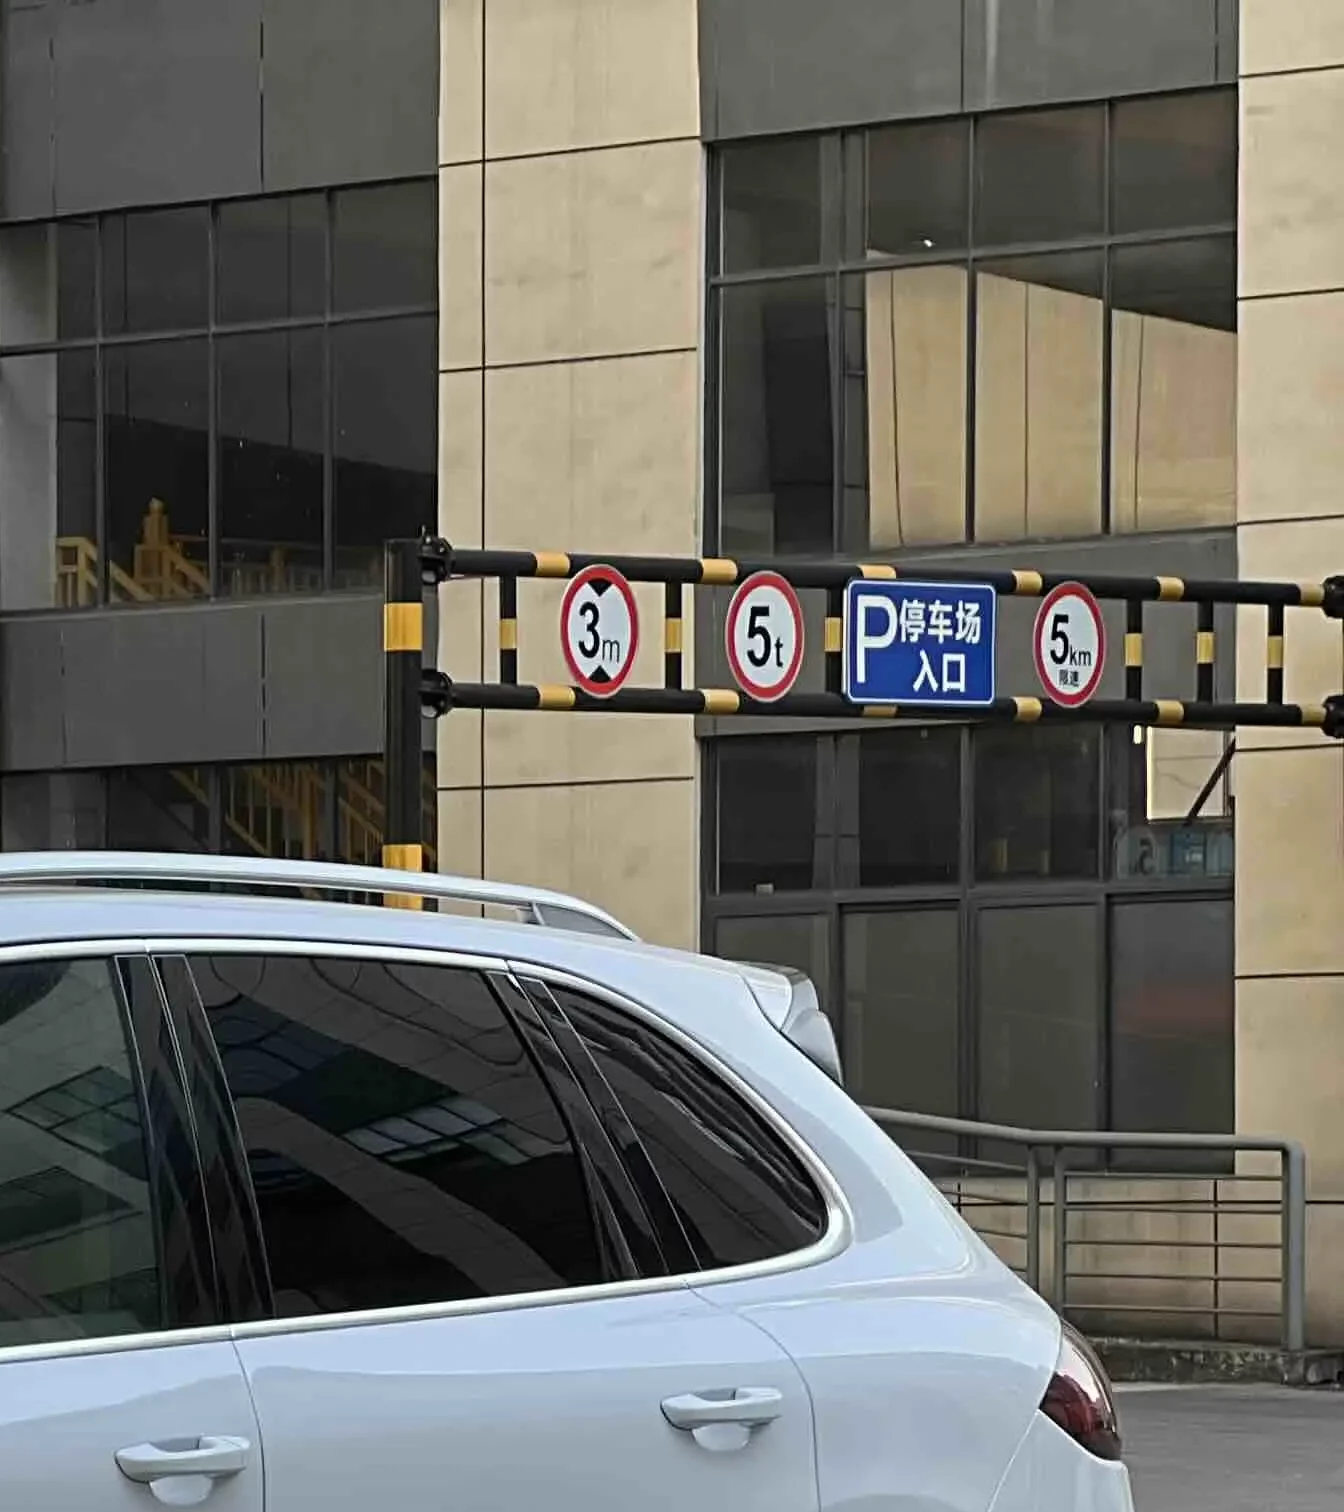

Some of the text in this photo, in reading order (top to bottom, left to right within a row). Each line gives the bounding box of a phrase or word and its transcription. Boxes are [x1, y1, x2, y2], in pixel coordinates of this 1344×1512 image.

[578, 601, 620, 663] 3m
[856, 594, 982, 684] P 停车场
[1049, 614, 1092, 666] 5km
[912, 650, 966, 693] 入口
